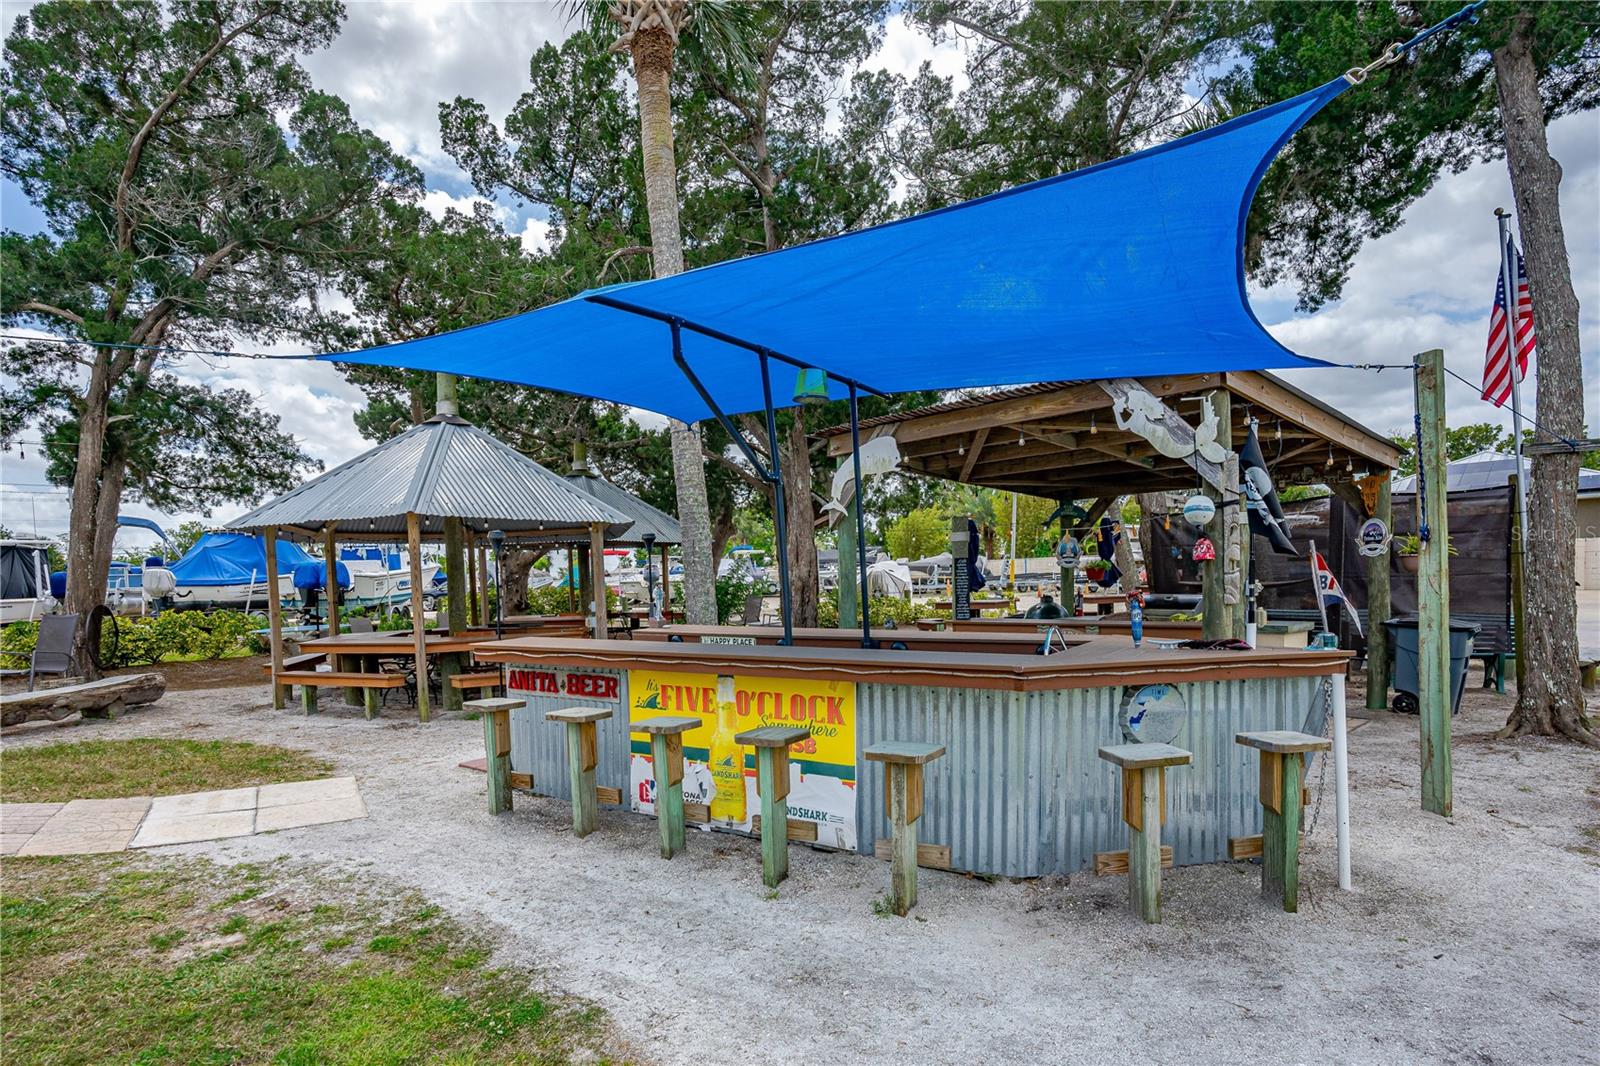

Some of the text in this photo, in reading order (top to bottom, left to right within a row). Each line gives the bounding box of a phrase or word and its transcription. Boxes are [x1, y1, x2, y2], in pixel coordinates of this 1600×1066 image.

[733, 638, 753, 646] PLACE
[508, 670, 618, 698] ANITA BEER
[660, 684, 845, 725] FIVE O'CLOCK
